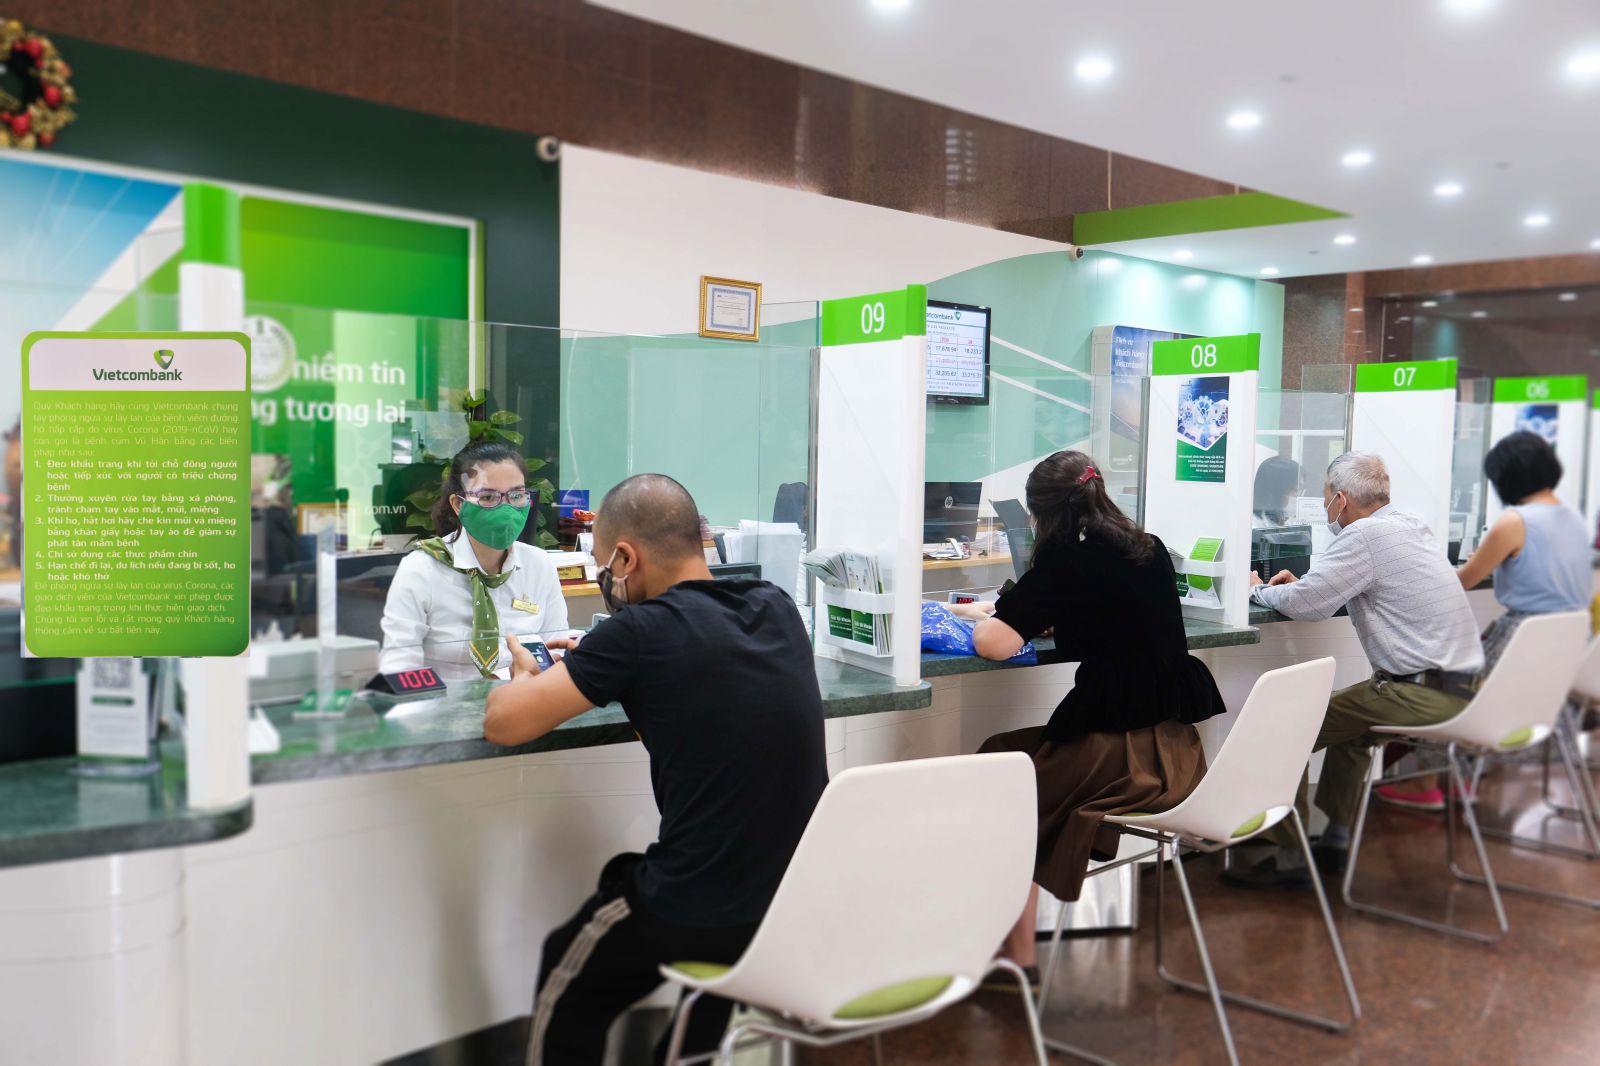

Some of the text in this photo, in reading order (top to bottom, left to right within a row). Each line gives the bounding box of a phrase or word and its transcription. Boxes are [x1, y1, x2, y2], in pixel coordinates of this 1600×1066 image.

[861, 302, 885, 334] 09
[1191, 344, 1217, 368] 08
[92, 368, 182, 381] Vietcombank
[293, 352, 405, 385] niềm tin
[1393, 367, 1417, 386] 07
[1526, 381, 1549, 399] 06
[285, 397, 369, 427] tương
[376, 399, 406, 423] lai
[98, 460, 123, 469] trang
[127, 460, 142, 468] khi
[142, 495, 157, 504] tay
[104, 506, 120, 515] tay
[48, 517, 63, 525] Khi
[66, 517, 80, 526] ho,
[137, 517, 154, 525] che
[149, 528, 164, 537] tay
[115, 562, 128, 570] du
[224, 562, 236, 570] ho
[399, 669, 437, 689] 100
